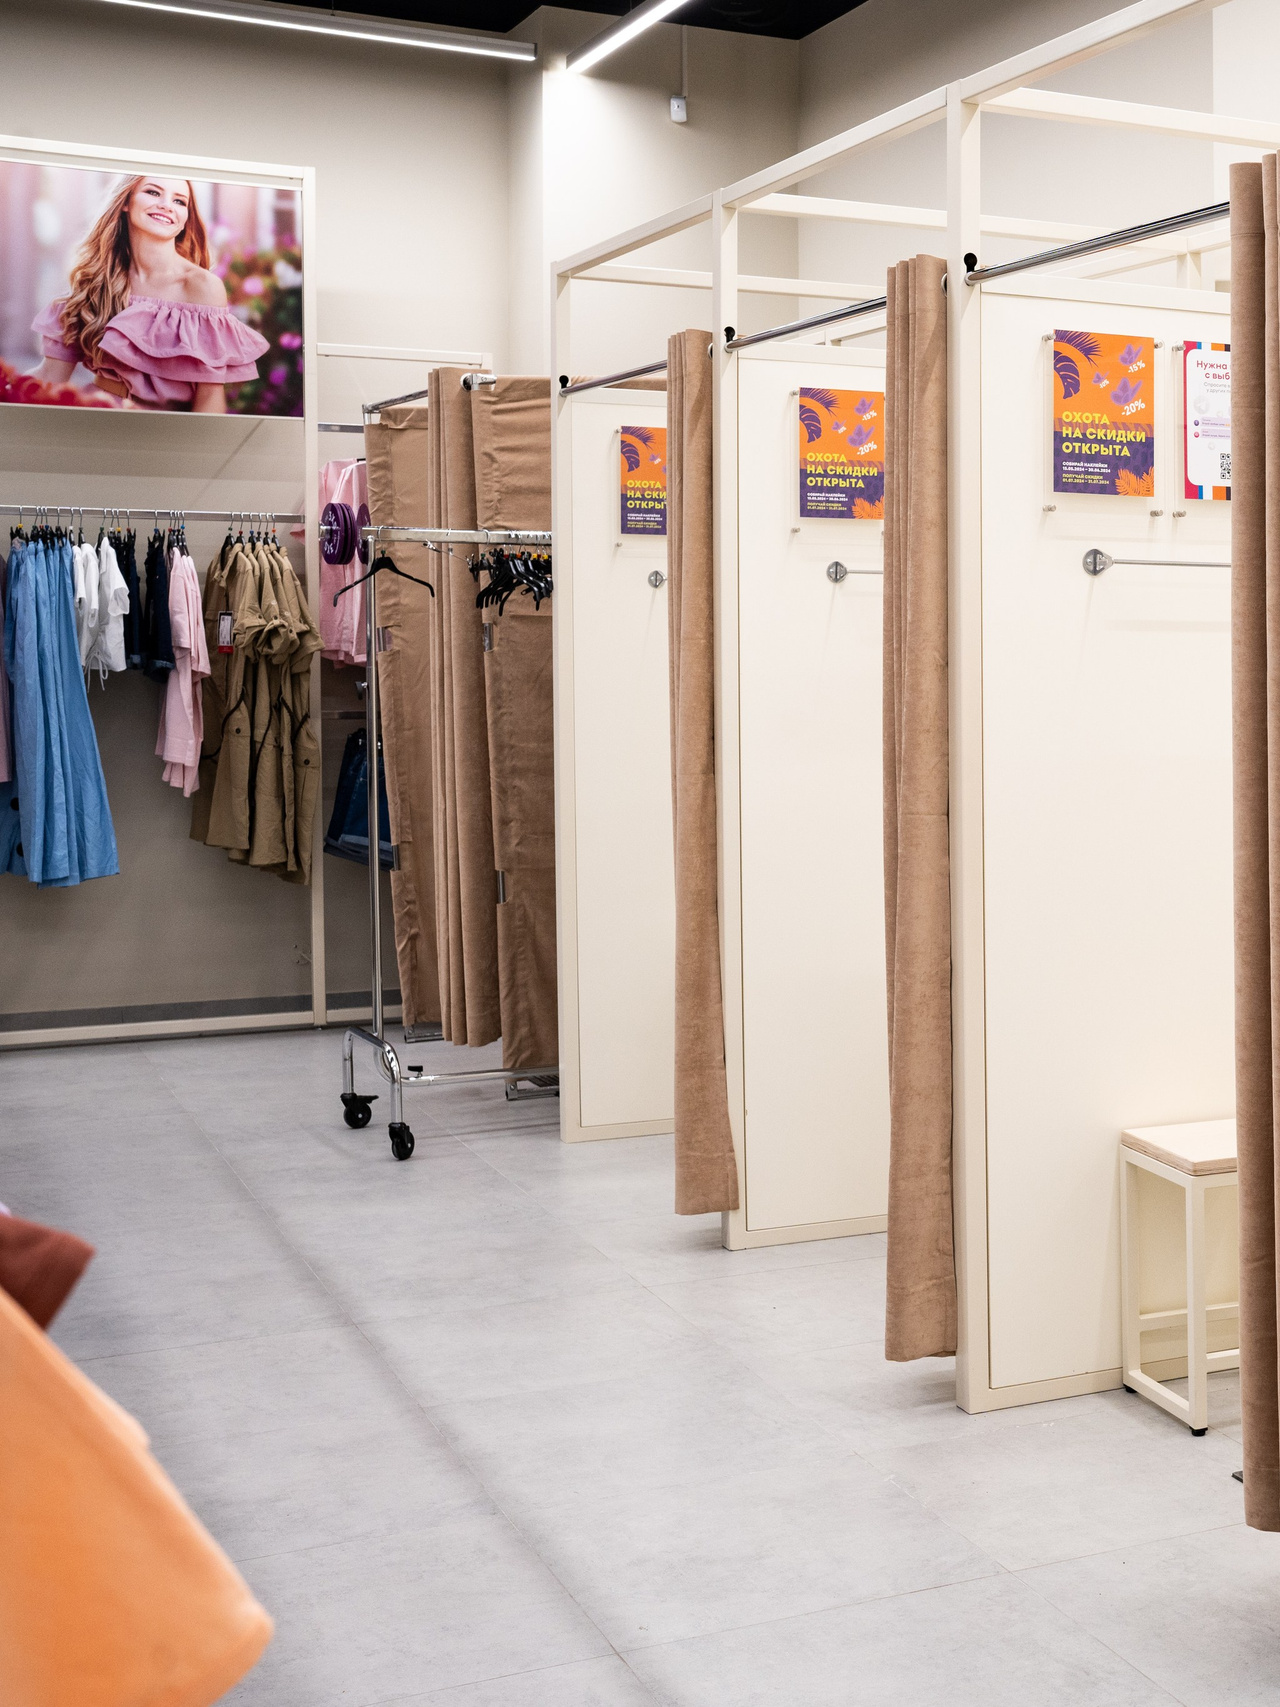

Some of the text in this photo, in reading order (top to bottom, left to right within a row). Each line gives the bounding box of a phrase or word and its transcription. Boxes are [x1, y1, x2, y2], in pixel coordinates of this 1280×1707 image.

[1128, 360, 1146, 373] -15%
[1196, 360, 1227, 370] Нужна
[1121, 399, 1145, 416] -20%
[862, 409, 877, 421] -15%
[1062, 411, 1110, 425] ОХОТА
[1062, 426, 1146, 443] НА СКИДКИ
[857, 441, 878, 455] -20%
[1062, 442, 1130, 456] ОТКРЫТА
[806, 452, 847, 463] ОХОТА
[806, 464, 878, 477] НА СКИДКИ
[627, 480, 662, 489] ОХОТА
[806, 477, 865, 488] ОТКРЫТА
[627, 490, 642, 498] НА
